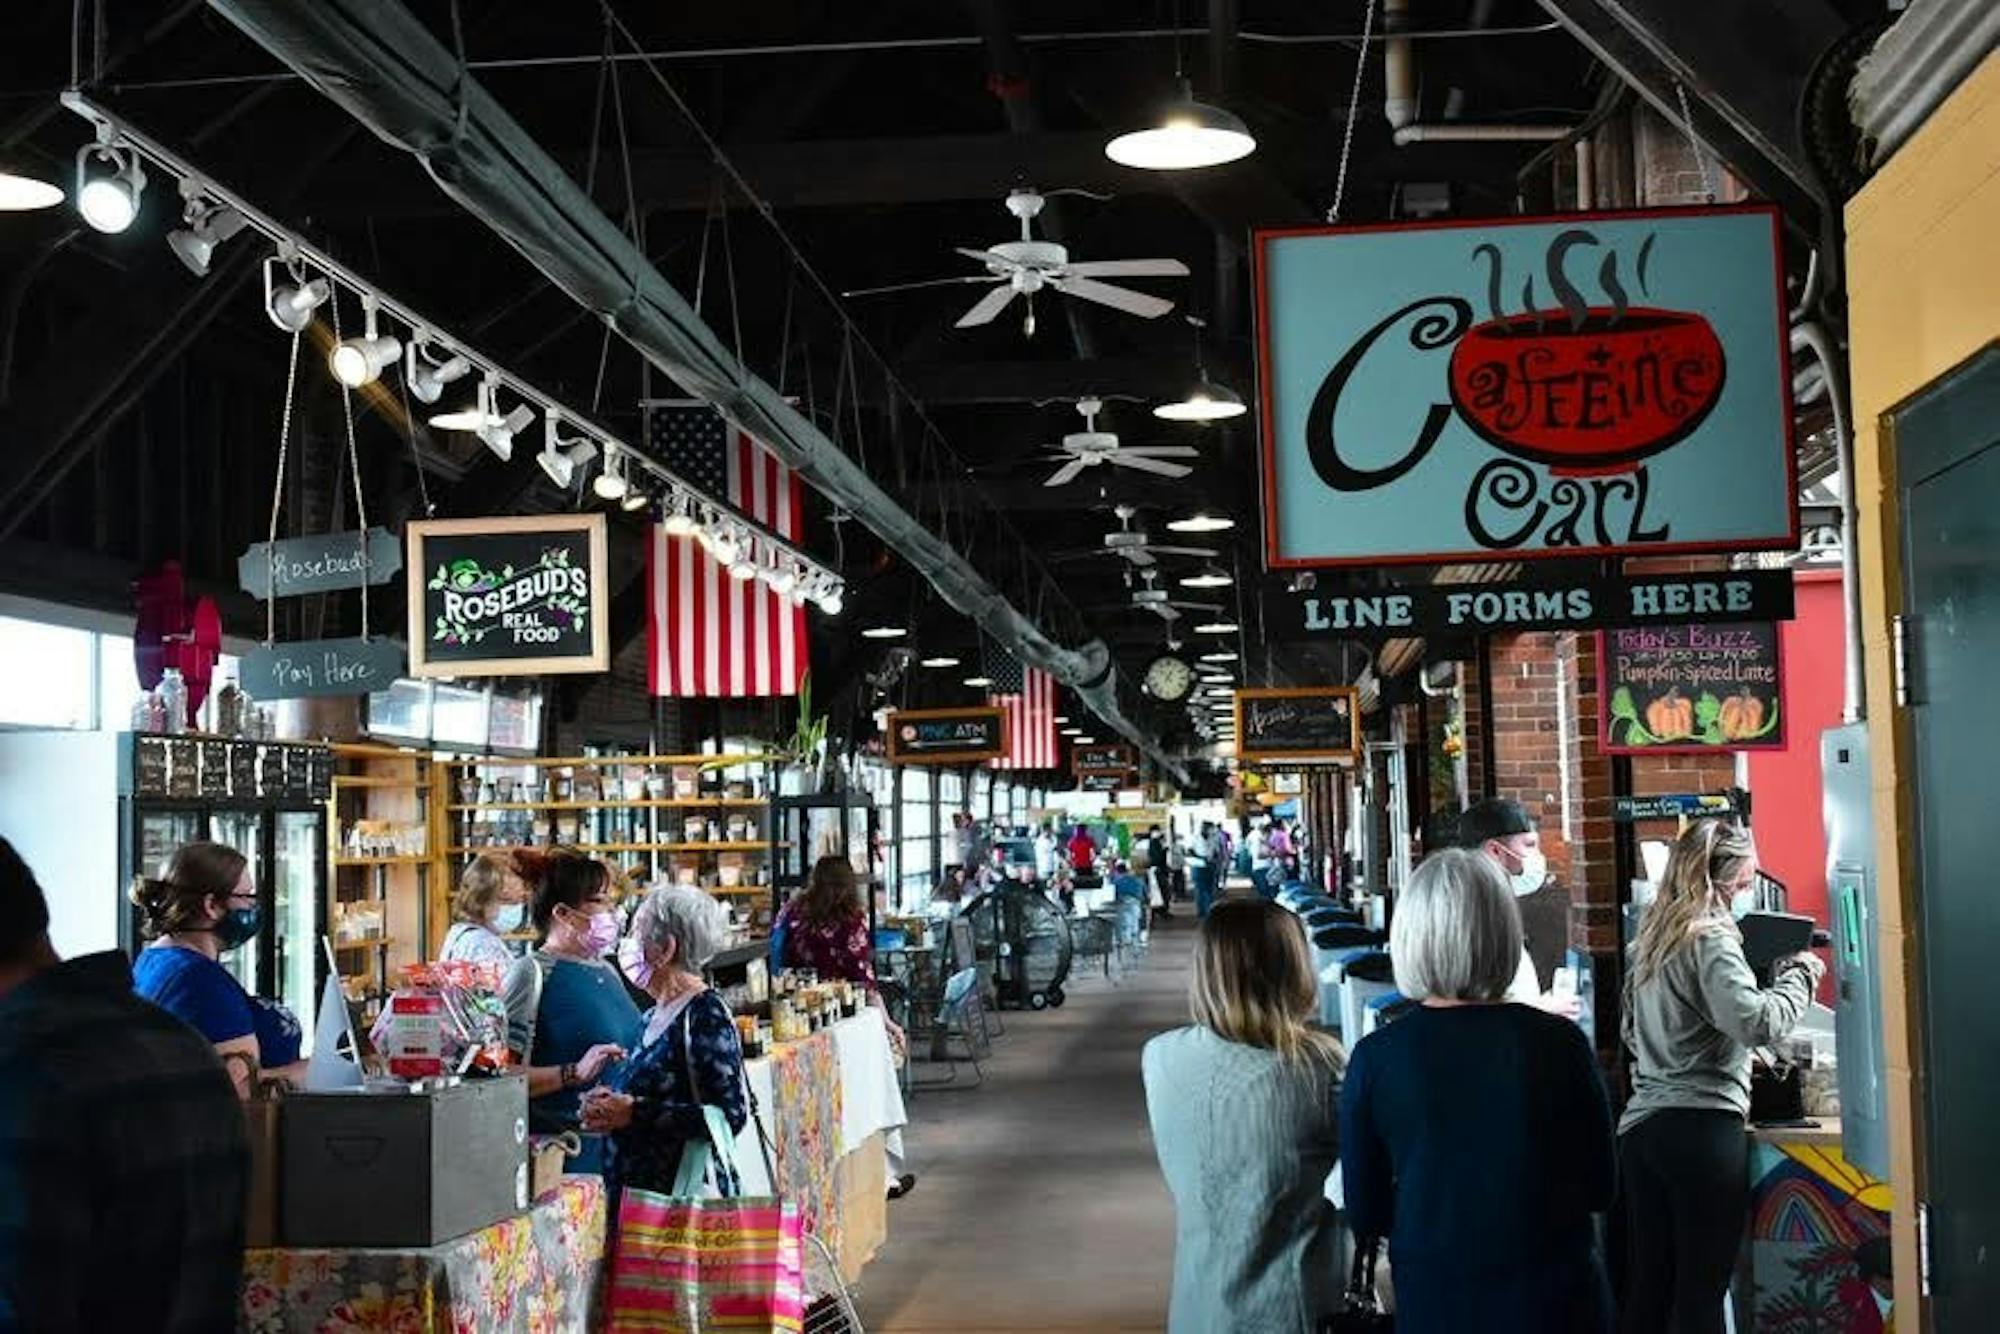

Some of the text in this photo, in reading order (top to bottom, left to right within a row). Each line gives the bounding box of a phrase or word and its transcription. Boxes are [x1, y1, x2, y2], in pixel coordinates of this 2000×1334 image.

[443, 567, 588, 625] ROSEBUD'S
[1304, 580, 1754, 631] LINE FORMS HERE
[502, 612, 543, 629] REAL
[514, 627, 560, 643] FOOD
[1689, 624, 1757, 648] Buzz
[272, 652, 376, 687] Pay Here
[954, 723, 988, 738] ATM
